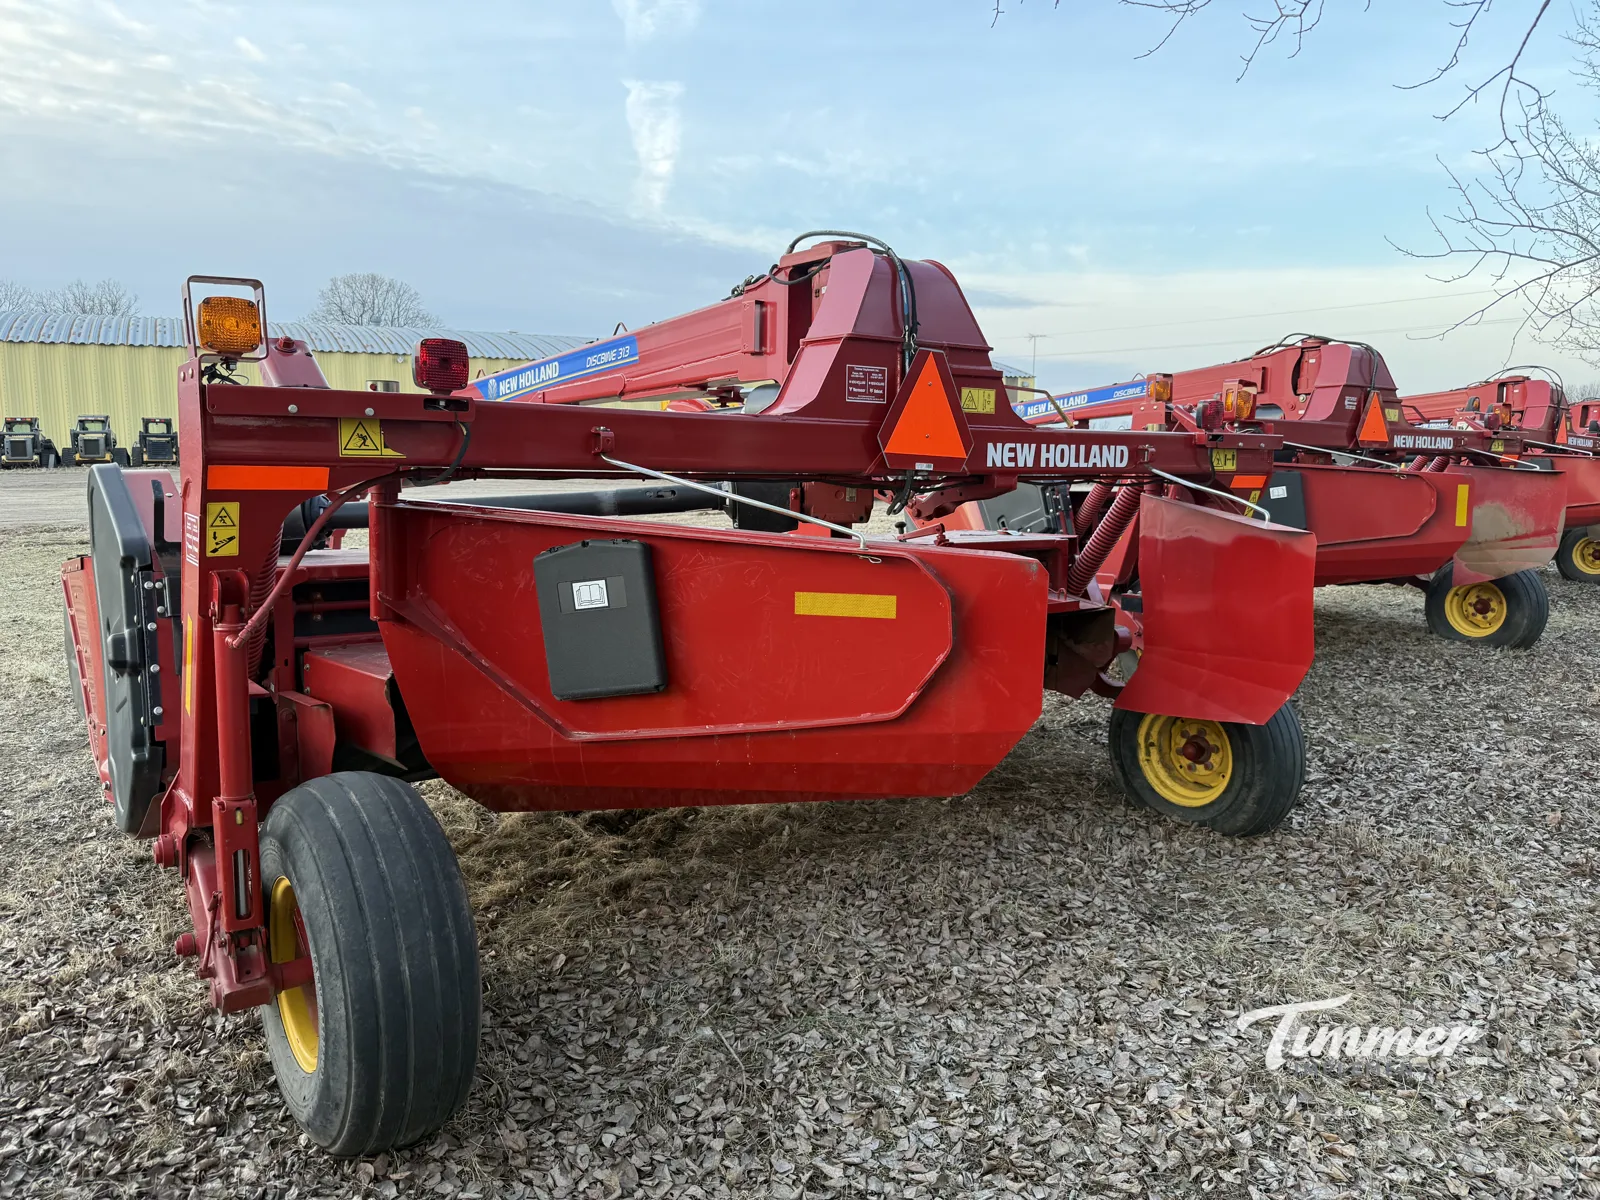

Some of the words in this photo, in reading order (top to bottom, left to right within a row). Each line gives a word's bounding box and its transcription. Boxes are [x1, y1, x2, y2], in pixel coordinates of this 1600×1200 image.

[499, 373, 520, 396] NEW
[519, 361, 559, 389] HOLLAND
[586, 349, 617, 368] DISCBINE
[617, 345, 631, 360] 313
[1027, 402, 1047, 416] NEW
[1393, 434, 1415, 448] NEW
[1415, 435, 1454, 450] HOLLAND
[986, 442, 1037, 468] NEW
[1039, 443, 1129, 468] HOLLAND
